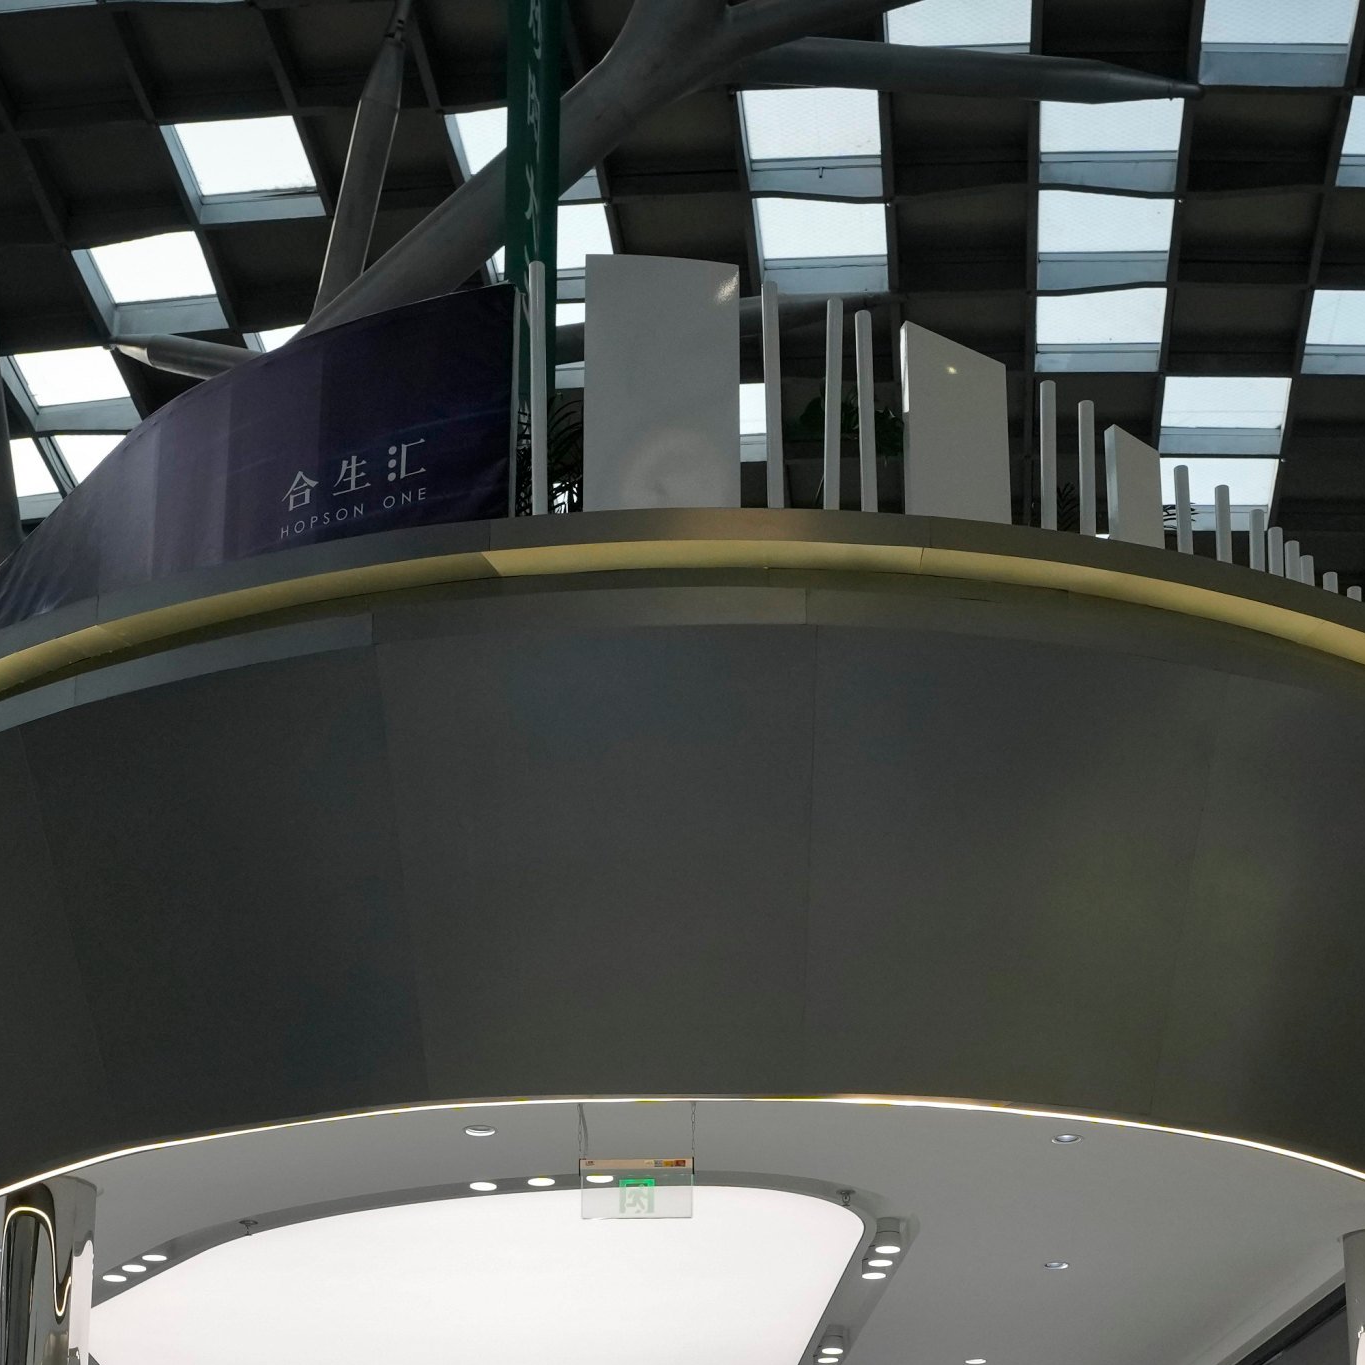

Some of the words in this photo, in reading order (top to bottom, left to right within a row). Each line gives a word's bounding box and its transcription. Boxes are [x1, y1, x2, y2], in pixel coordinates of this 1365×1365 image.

[281, 437, 427, 512] 合生汇
[280, 503, 365, 540] HOPSON
[382, 487, 427, 509] ONE
